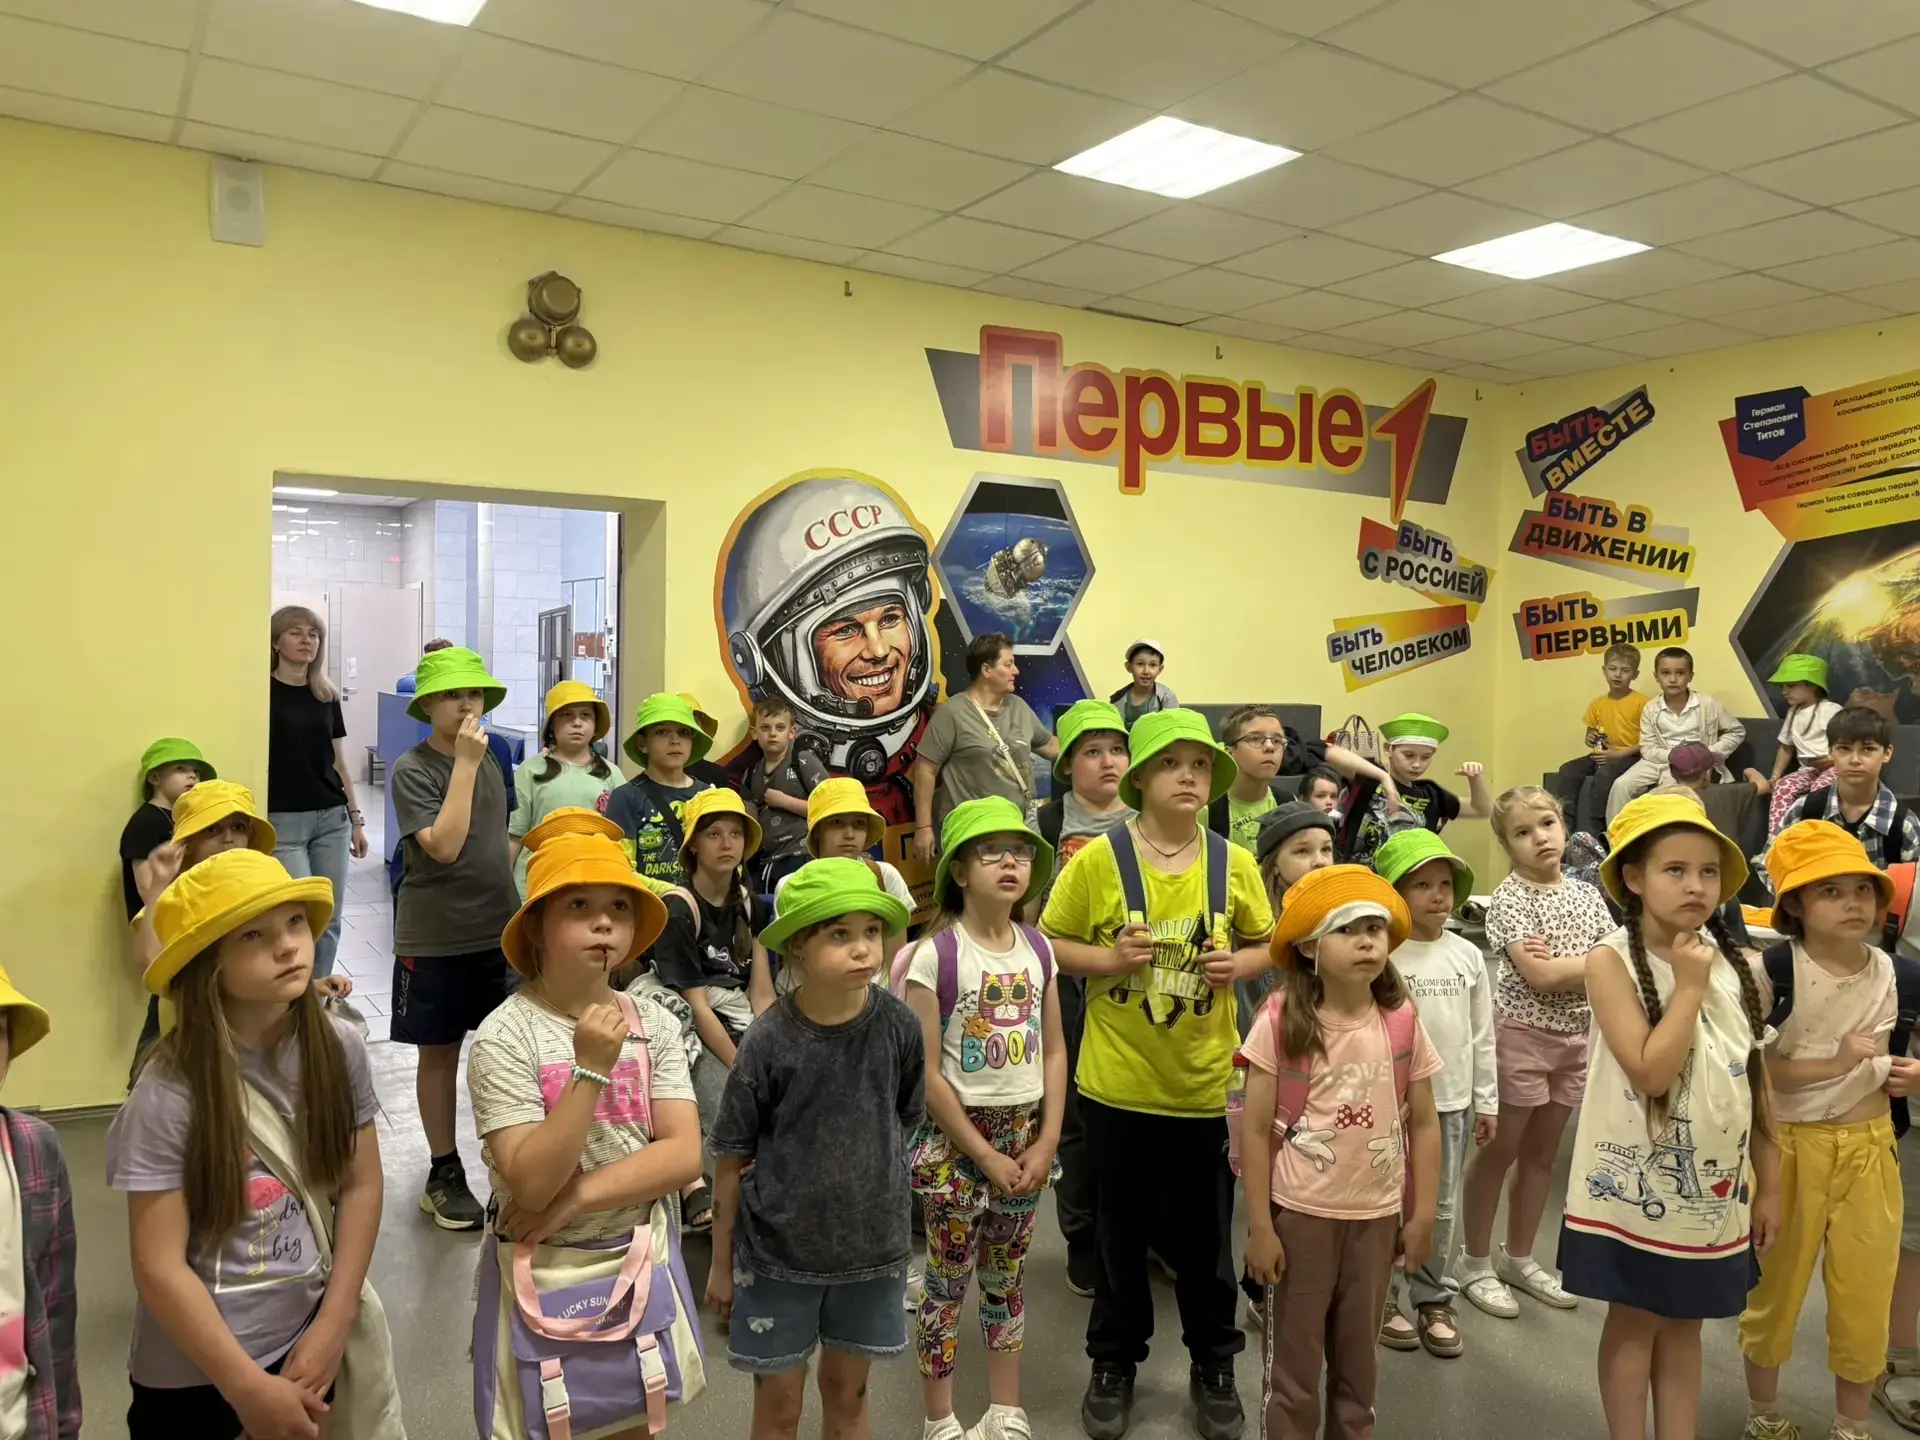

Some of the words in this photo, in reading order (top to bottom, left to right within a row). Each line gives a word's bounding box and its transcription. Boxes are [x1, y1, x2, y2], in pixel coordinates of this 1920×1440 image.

[1833, 388, 1887, 407] Докладывает
[1888, 380, 1920, 393] команд
[983, 330, 1366, 491] Первые
[1751, 403, 1785, 417] Герман
[1837, 398, 1894, 417] космического
[1743, 412, 1798, 431] Степанович
[1530, 413, 1605, 457] БЫТЬ
[1545, 398, 1649, 489] ВМЕСТЕ
[1757, 429, 1785, 441] Титов
[1825, 441, 1859, 457] корабля
[1851, 447, 1876, 460] Прошу
[1878, 437, 1917, 452] передать
[1811, 466, 1856, 483] советскому
[1797, 497, 1824, 509] Герман
[1825, 494, 1845, 503] Титов
[1847, 486, 1887, 499] совершил
[1888, 478, 1919, 490] первый
[1825, 502, 1862, 514] человека
[1874, 493, 1910, 505] корабле
[804, 504, 882, 551] СССР
[1546, 497, 1618, 529] БЫТЬ
[1626, 511, 1647, 533] В
[1398, 525, 1453, 564] БЫТЬ
[1525, 522, 1690, 573] ДВИЖЕНИИ
[1363, 551, 1380, 574] С
[1385, 555, 1484, 597] РОССИЕЙ
[1525, 598, 1598, 627] БЫТЬ
[1331, 627, 1383, 657] БЫТЬ
[1535, 615, 1682, 654] ПЕРВЫМИ
[1351, 627, 1467, 675] ЧЕЛОВЕКОМ
[1233, 815, 1252, 831] SMILE
[641, 852, 658, 862] THE
[1149, 917, 1193, 939] AUTO
[1153, 943, 1187, 968] SERVICE
[1415, 988, 1459, 997] EXPLORER
[1417, 978, 1457, 987] COMFORT
[272, 1234, 302, 1263] big
[945, 1250, 965, 1264] GO
[992, 1247, 1009, 1272] NICE
